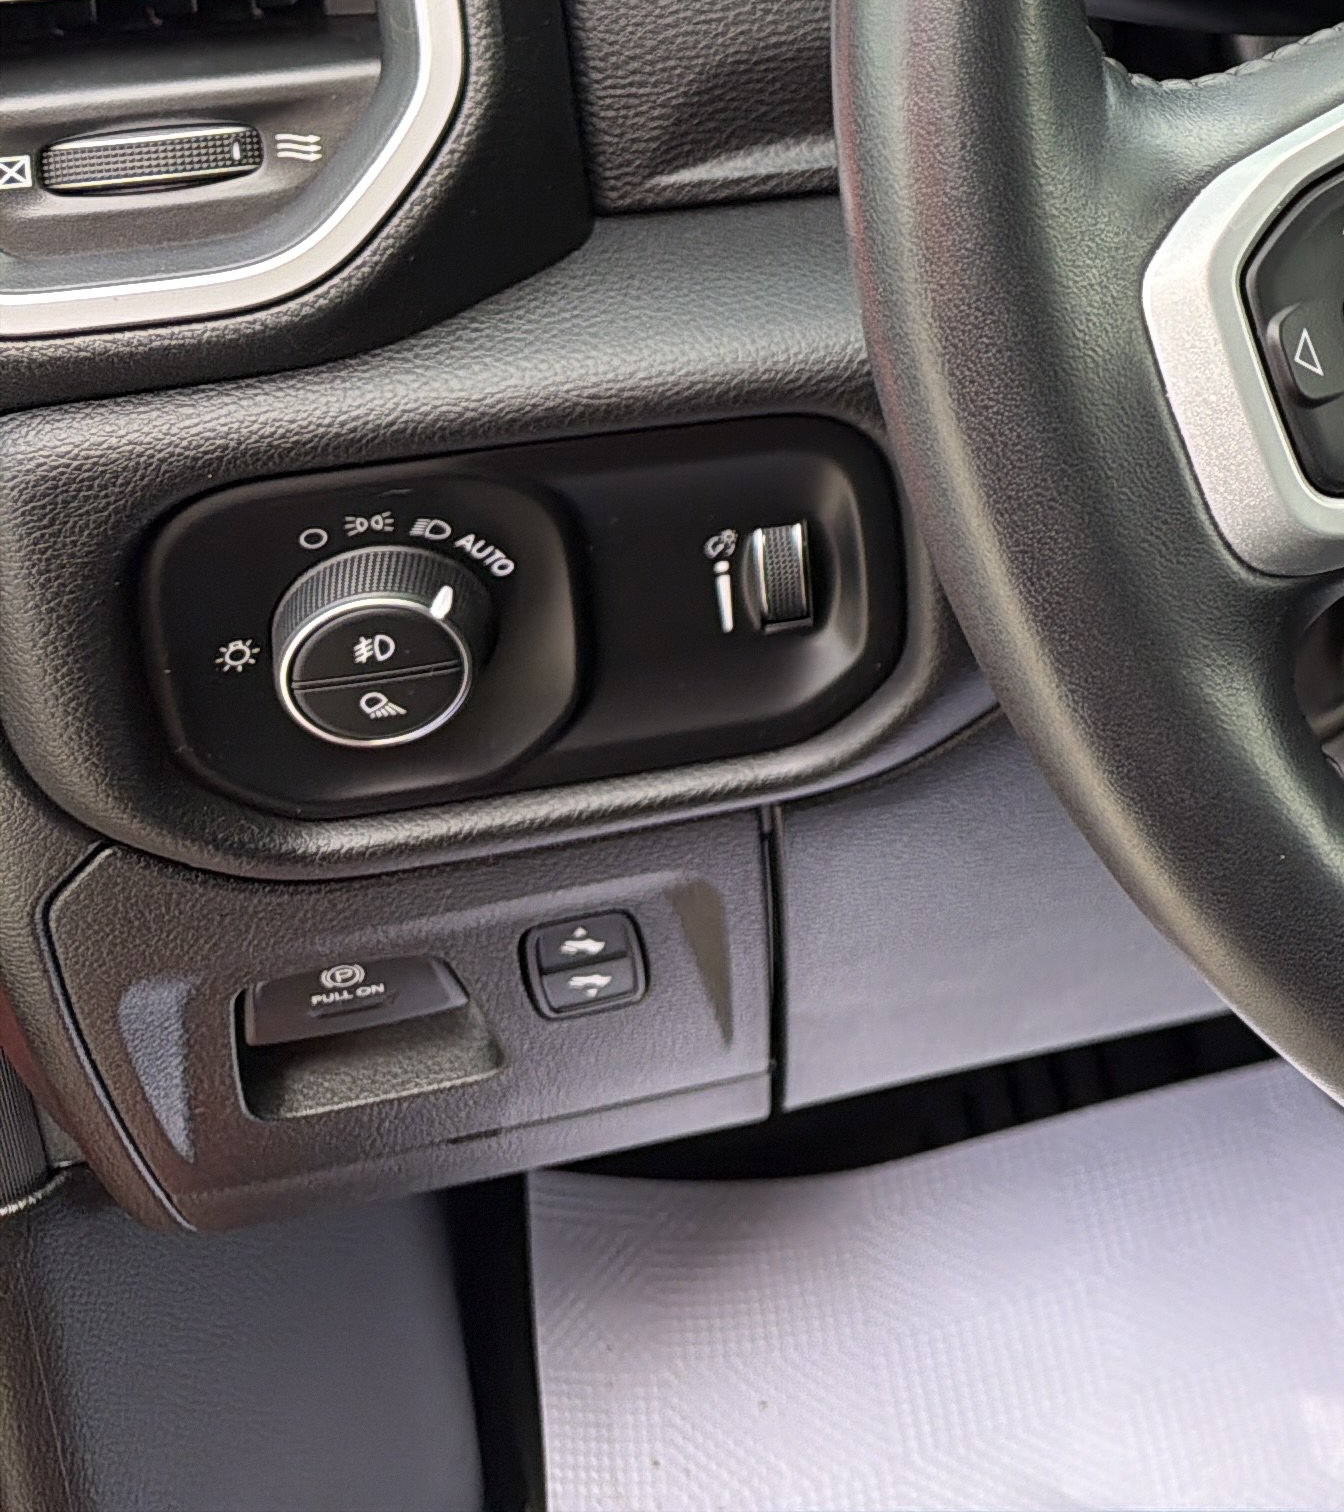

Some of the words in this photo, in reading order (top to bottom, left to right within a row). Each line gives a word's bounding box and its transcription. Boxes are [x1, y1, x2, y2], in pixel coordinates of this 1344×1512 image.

[453, 533, 515, 577] AUTO
[311, 989, 354, 1007] PULL
[355, 982, 385, 998] ON
